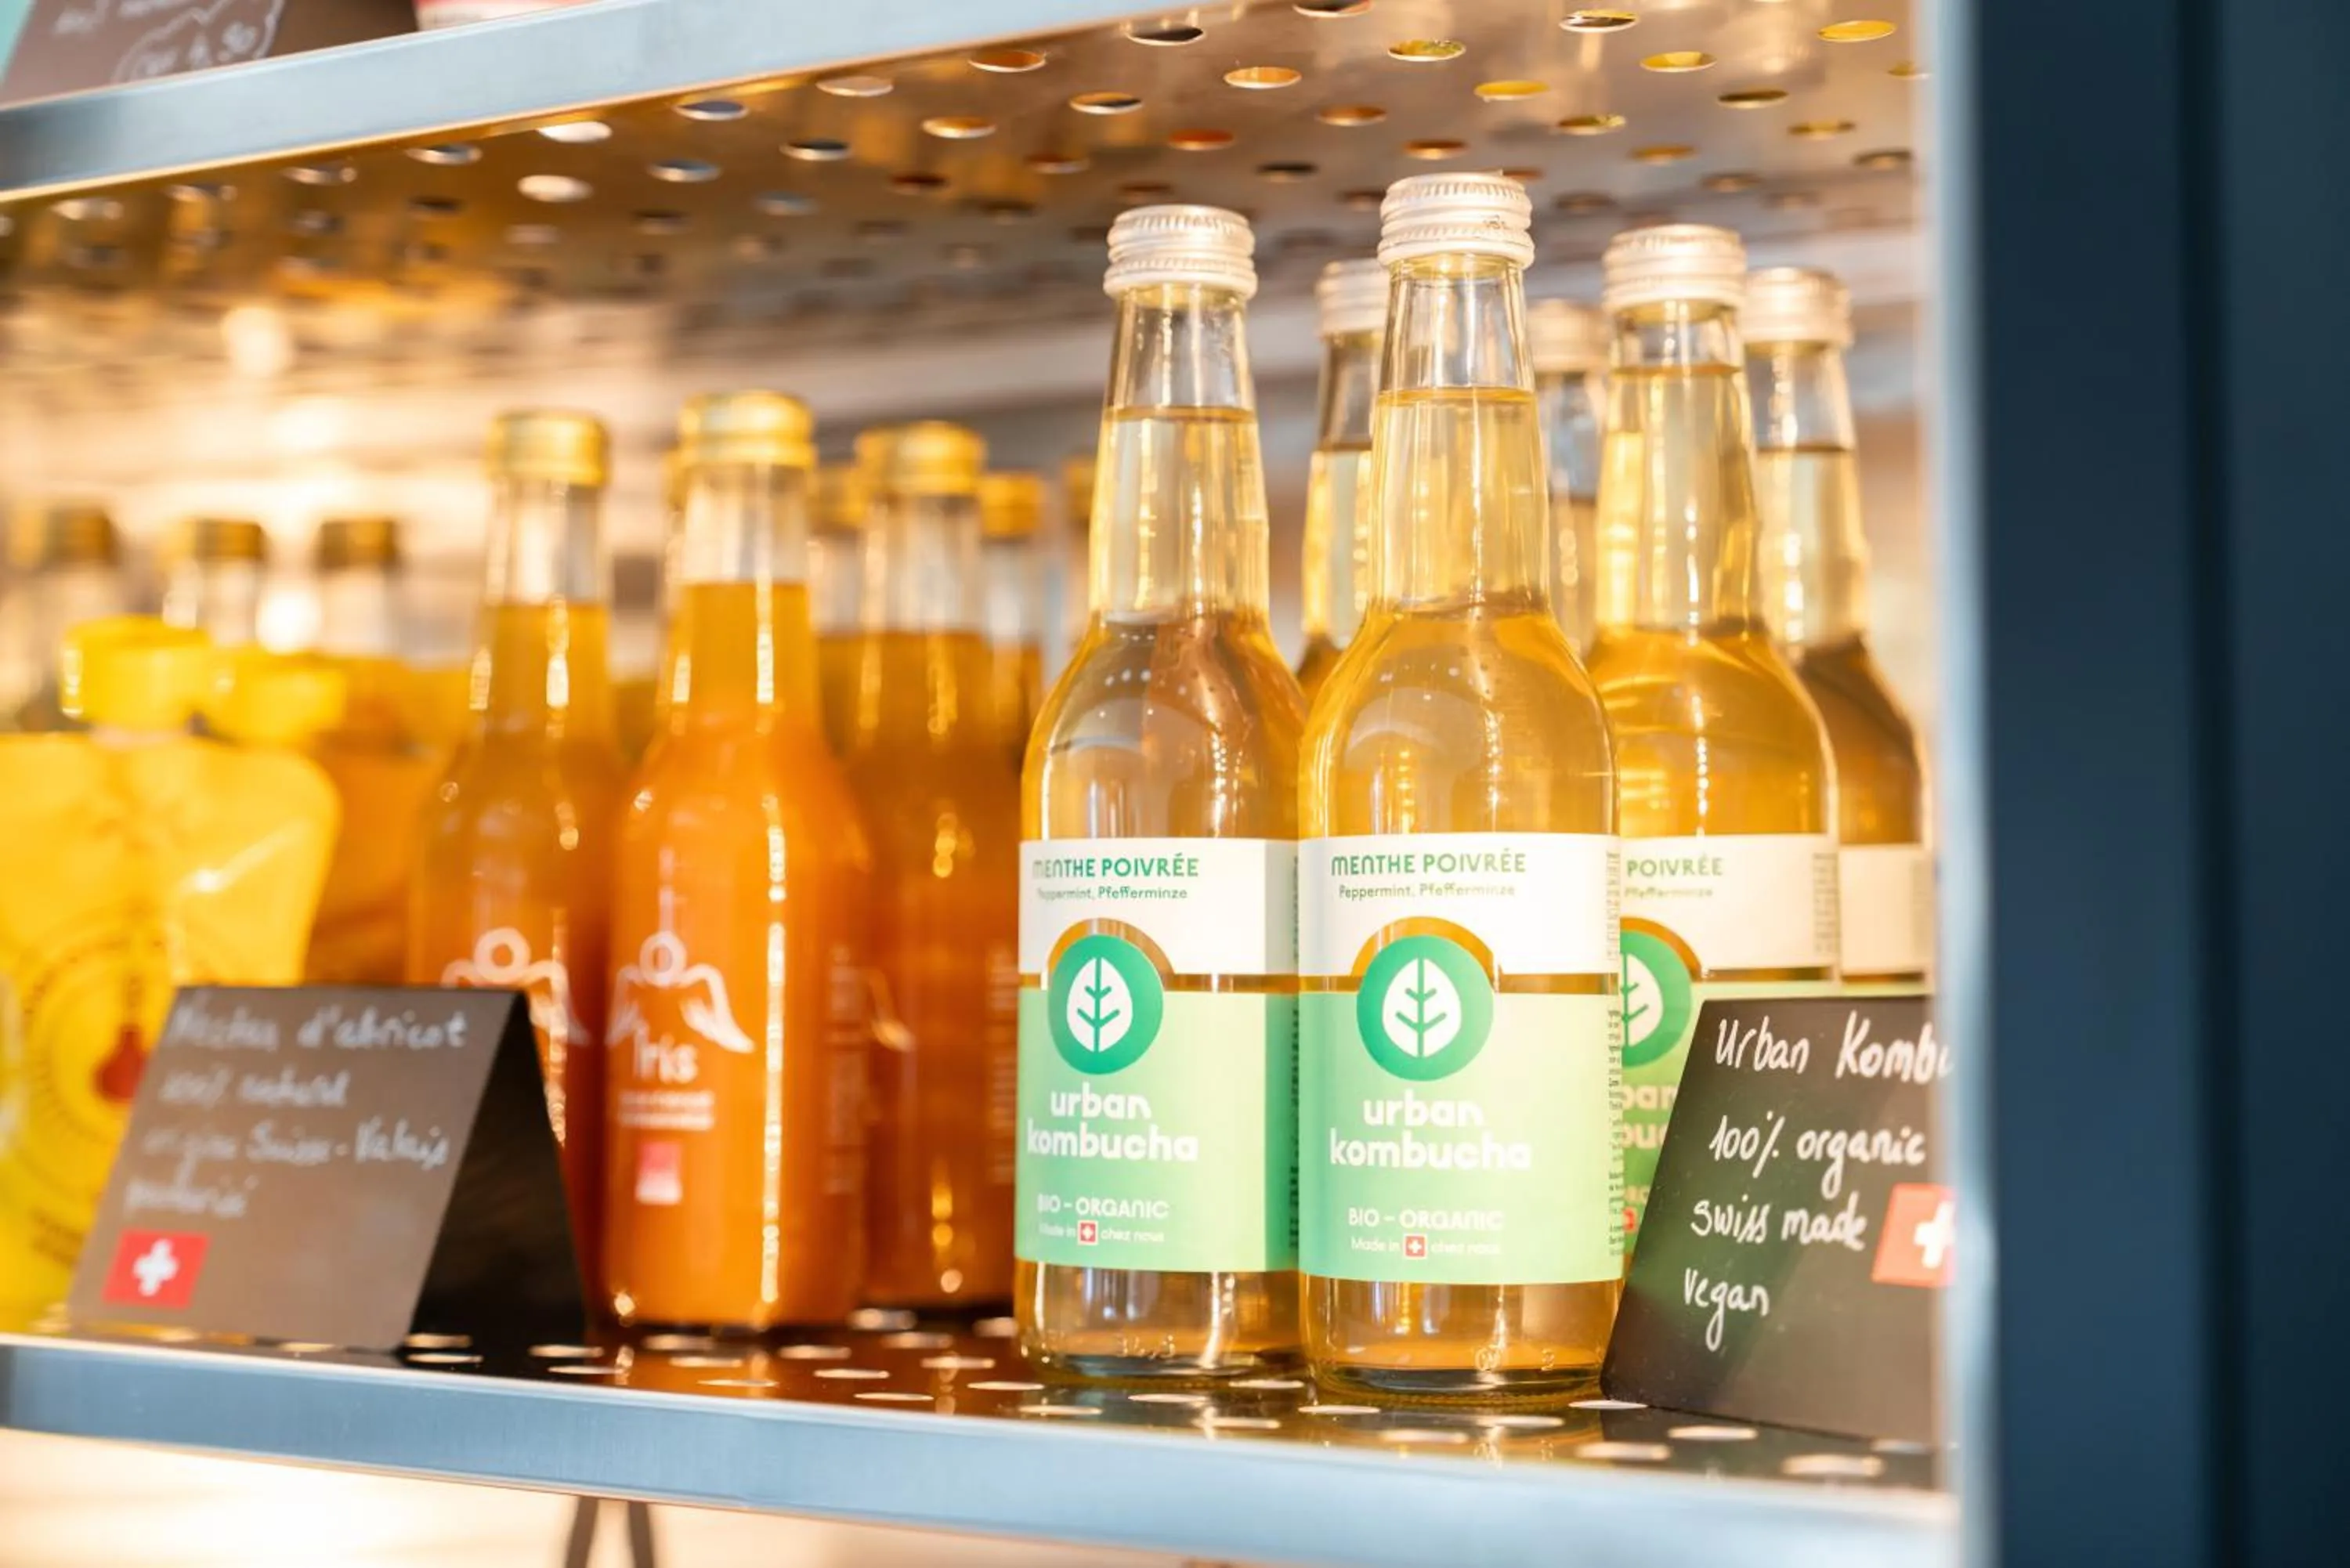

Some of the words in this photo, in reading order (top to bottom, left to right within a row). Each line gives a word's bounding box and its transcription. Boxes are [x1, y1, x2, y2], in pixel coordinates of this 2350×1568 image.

[1032, 858, 1096, 878] MENTHE
[1101, 852, 1199, 877] POIVRÉE
[1331, 854, 1415, 876] MENTHE
[1423, 848, 1526, 873] POIVRÉE
[1626, 851, 1723, 877] POIVRÉE
[1098, 886, 1187, 899] Pfefferminze
[1715, 1016, 1810, 1075] Urban
[1050, 1082, 1152, 1119] urban
[1363, 1089, 1484, 1127] urban
[1028, 1117, 1198, 1162] kombucha
[1330, 1128, 1531, 1169] kombucha
[1709, 1111, 1786, 1178] 100%
[1795, 1126, 1925, 1199] organic
[1076, 1196, 1170, 1219] ORGANIC
[1348, 1208, 1379, 1227] BIO
[1399, 1209, 1505, 1230] ORGANIC
[1781, 1193, 1867, 1251] made
